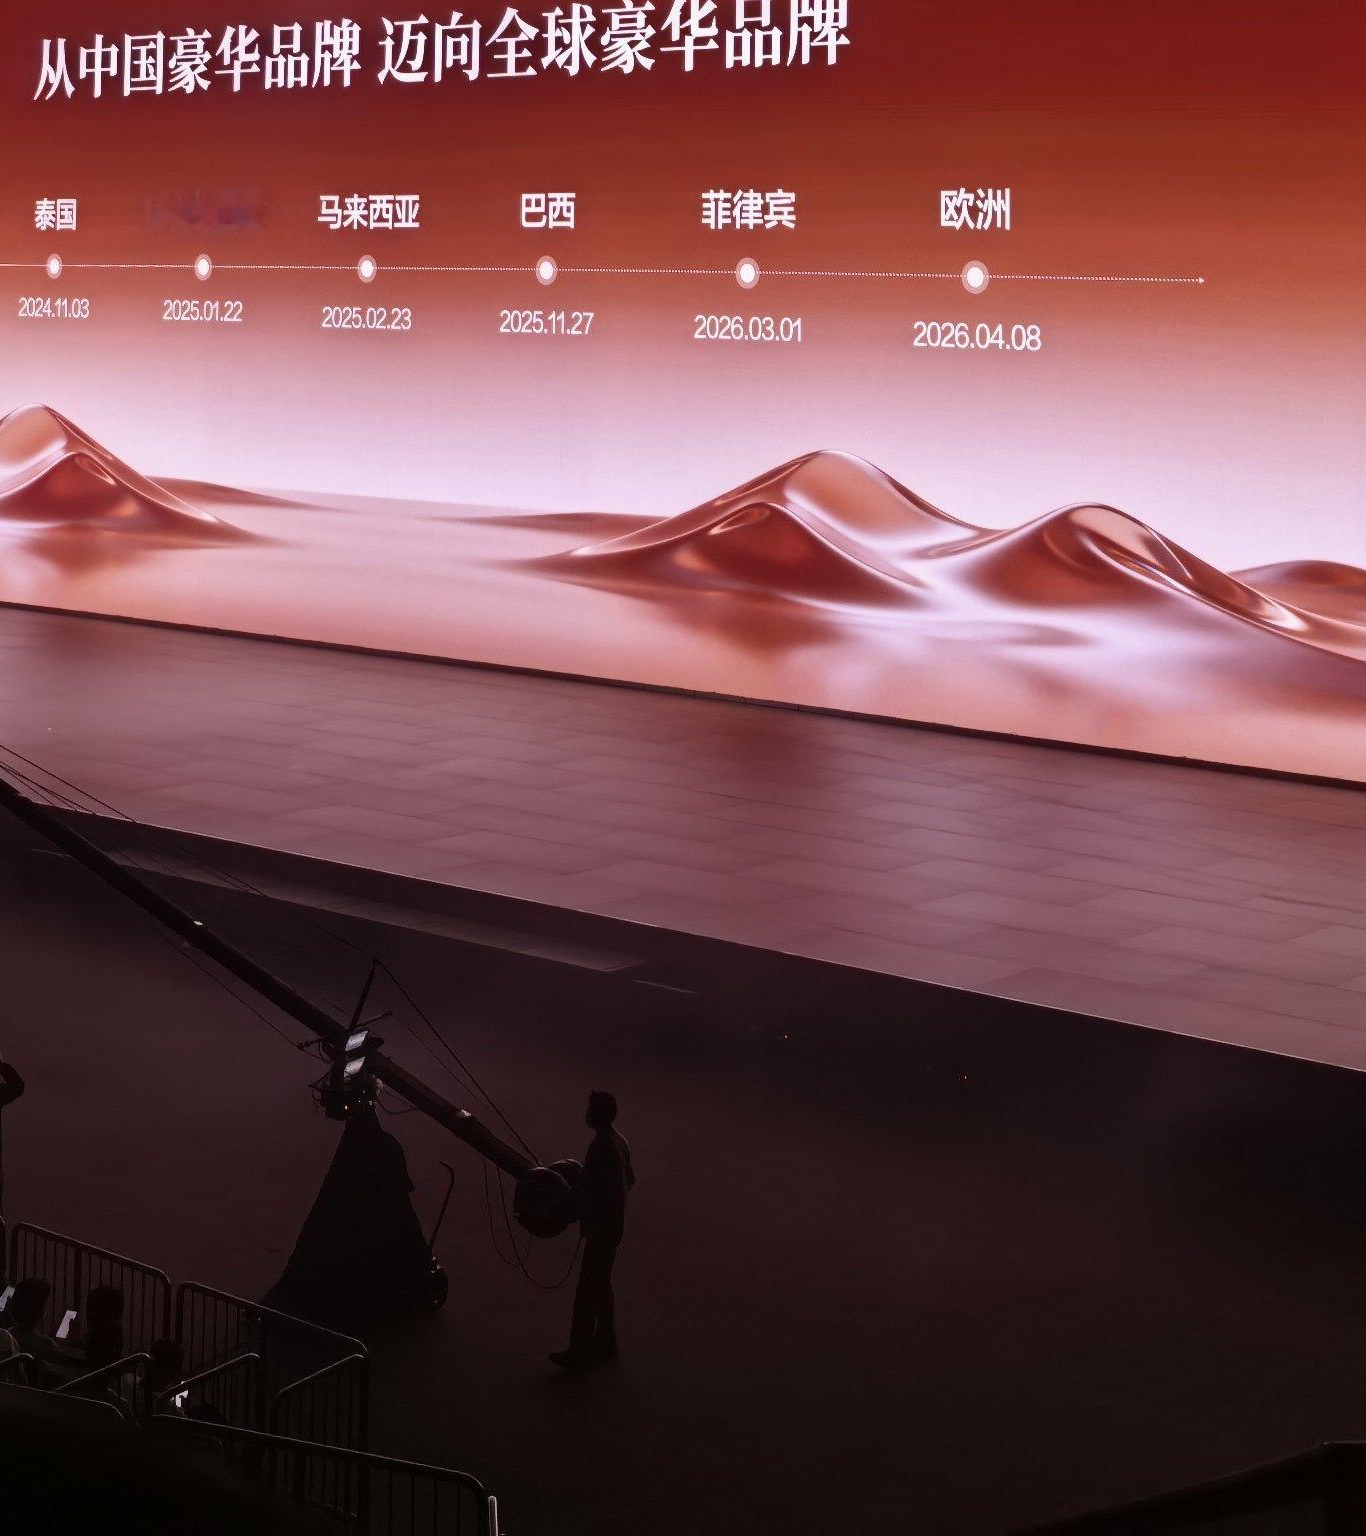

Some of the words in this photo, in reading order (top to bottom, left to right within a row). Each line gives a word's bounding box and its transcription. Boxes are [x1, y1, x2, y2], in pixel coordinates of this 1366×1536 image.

[33, 17, 362, 101] 从中国豪华品牌
[34, 197, 77, 231] 泰国
[317, 193, 420, 230] 马来西亚
[521, 192, 576, 229] 巴西
[701, 188, 797, 230] 菲律宾
[940, 187, 1011, 231] 欧洲
[18, 296, 90, 319] 2024.11.03
[162, 299, 243, 322] 2025.01.22
[321, 305, 412, 330] 2025.02.23
[499, 309, 595, 335] 2025.11.27
[693, 314, 802, 343] 2026.03.01
[912, 320, 1042, 352] 2026.04.08
